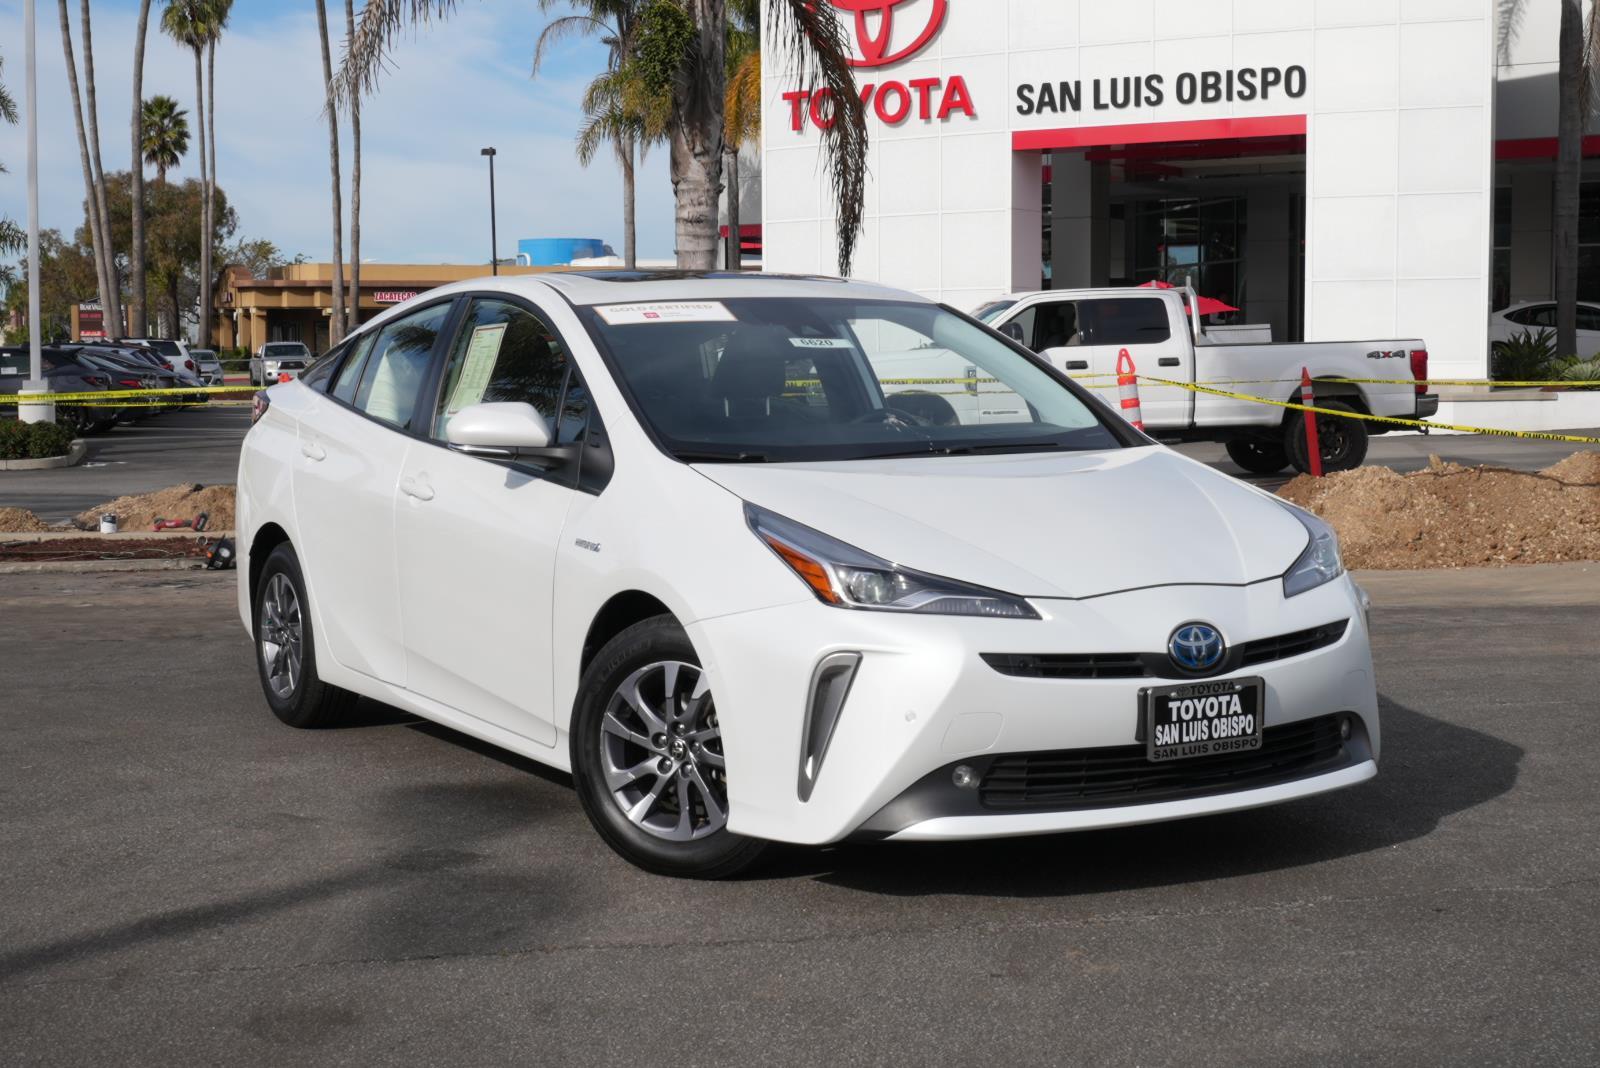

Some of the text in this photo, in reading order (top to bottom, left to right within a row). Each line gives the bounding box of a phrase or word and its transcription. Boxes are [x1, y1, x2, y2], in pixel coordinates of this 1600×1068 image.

[1016, 65, 1307, 115] SAN LUIS OBISPO
[1190, 681, 1236, 695] TOYOTA
[1168, 694, 1242, 721] TOYOTA
[1155, 714, 1254, 746] SAN LUIS OBISPO
[1153, 738, 1258, 760] SAN LUIS OBISPO
